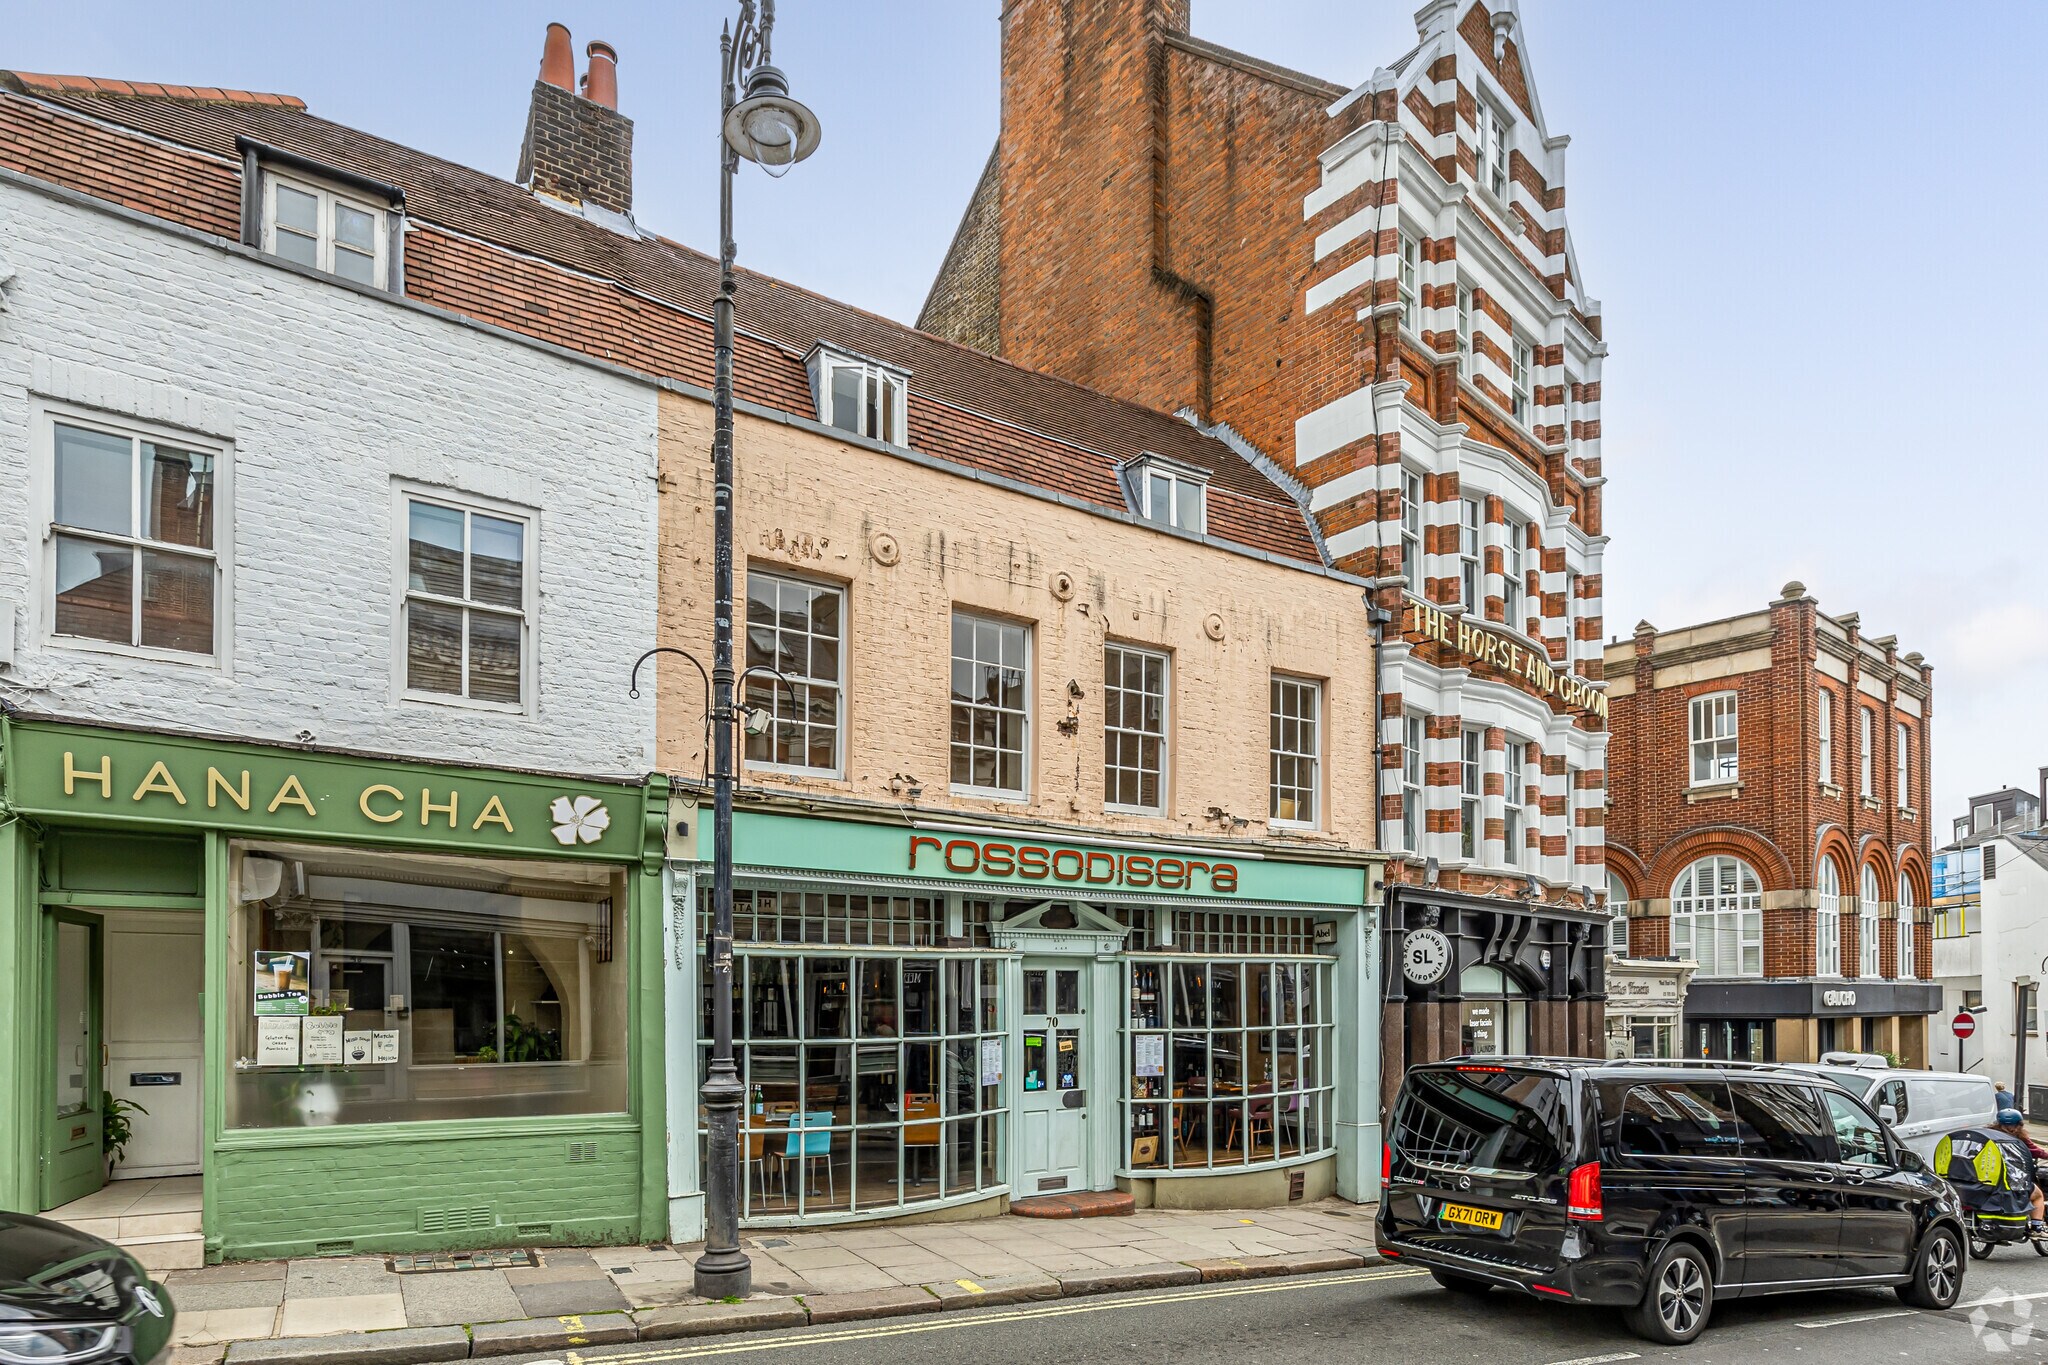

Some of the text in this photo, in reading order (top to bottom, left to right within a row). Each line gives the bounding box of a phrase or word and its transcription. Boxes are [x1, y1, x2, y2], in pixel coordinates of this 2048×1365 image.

[1410, 599, 1609, 720] THE HORSE AND GROOM
[63, 751, 514, 833] HANA CHA
[1316, 929, 1331, 938] Abel
[1415, 933, 1444, 957] LAUNDRY
[1412, 949, 1433, 964] SL
[1403, 962, 1443, 981] CALIFORNIA
[1823, 990, 1856, 1006] GAUCHO
[1046, 1017, 1059, 1028] 70
[1448, 1207, 1498, 1226] GX71 ORW
